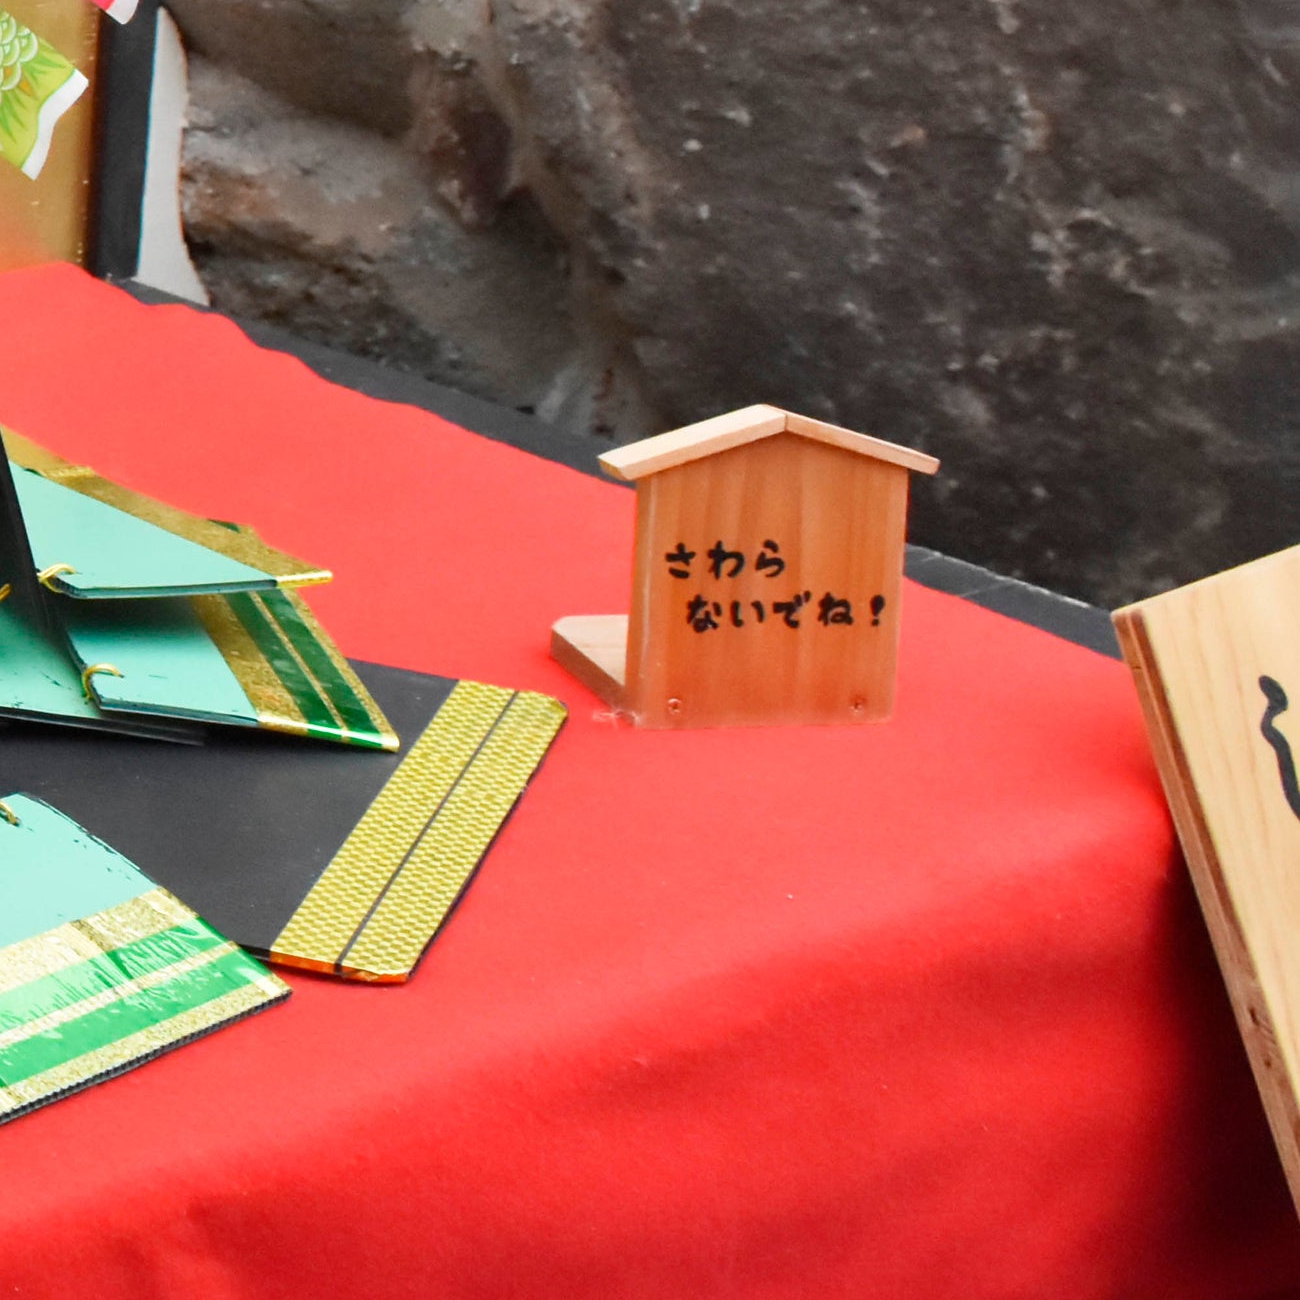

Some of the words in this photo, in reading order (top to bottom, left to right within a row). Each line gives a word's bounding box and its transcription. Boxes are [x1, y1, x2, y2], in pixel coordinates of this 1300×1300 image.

[664, 539, 786, 580] さわら
[685, 590, 886, 634] ないでね!
